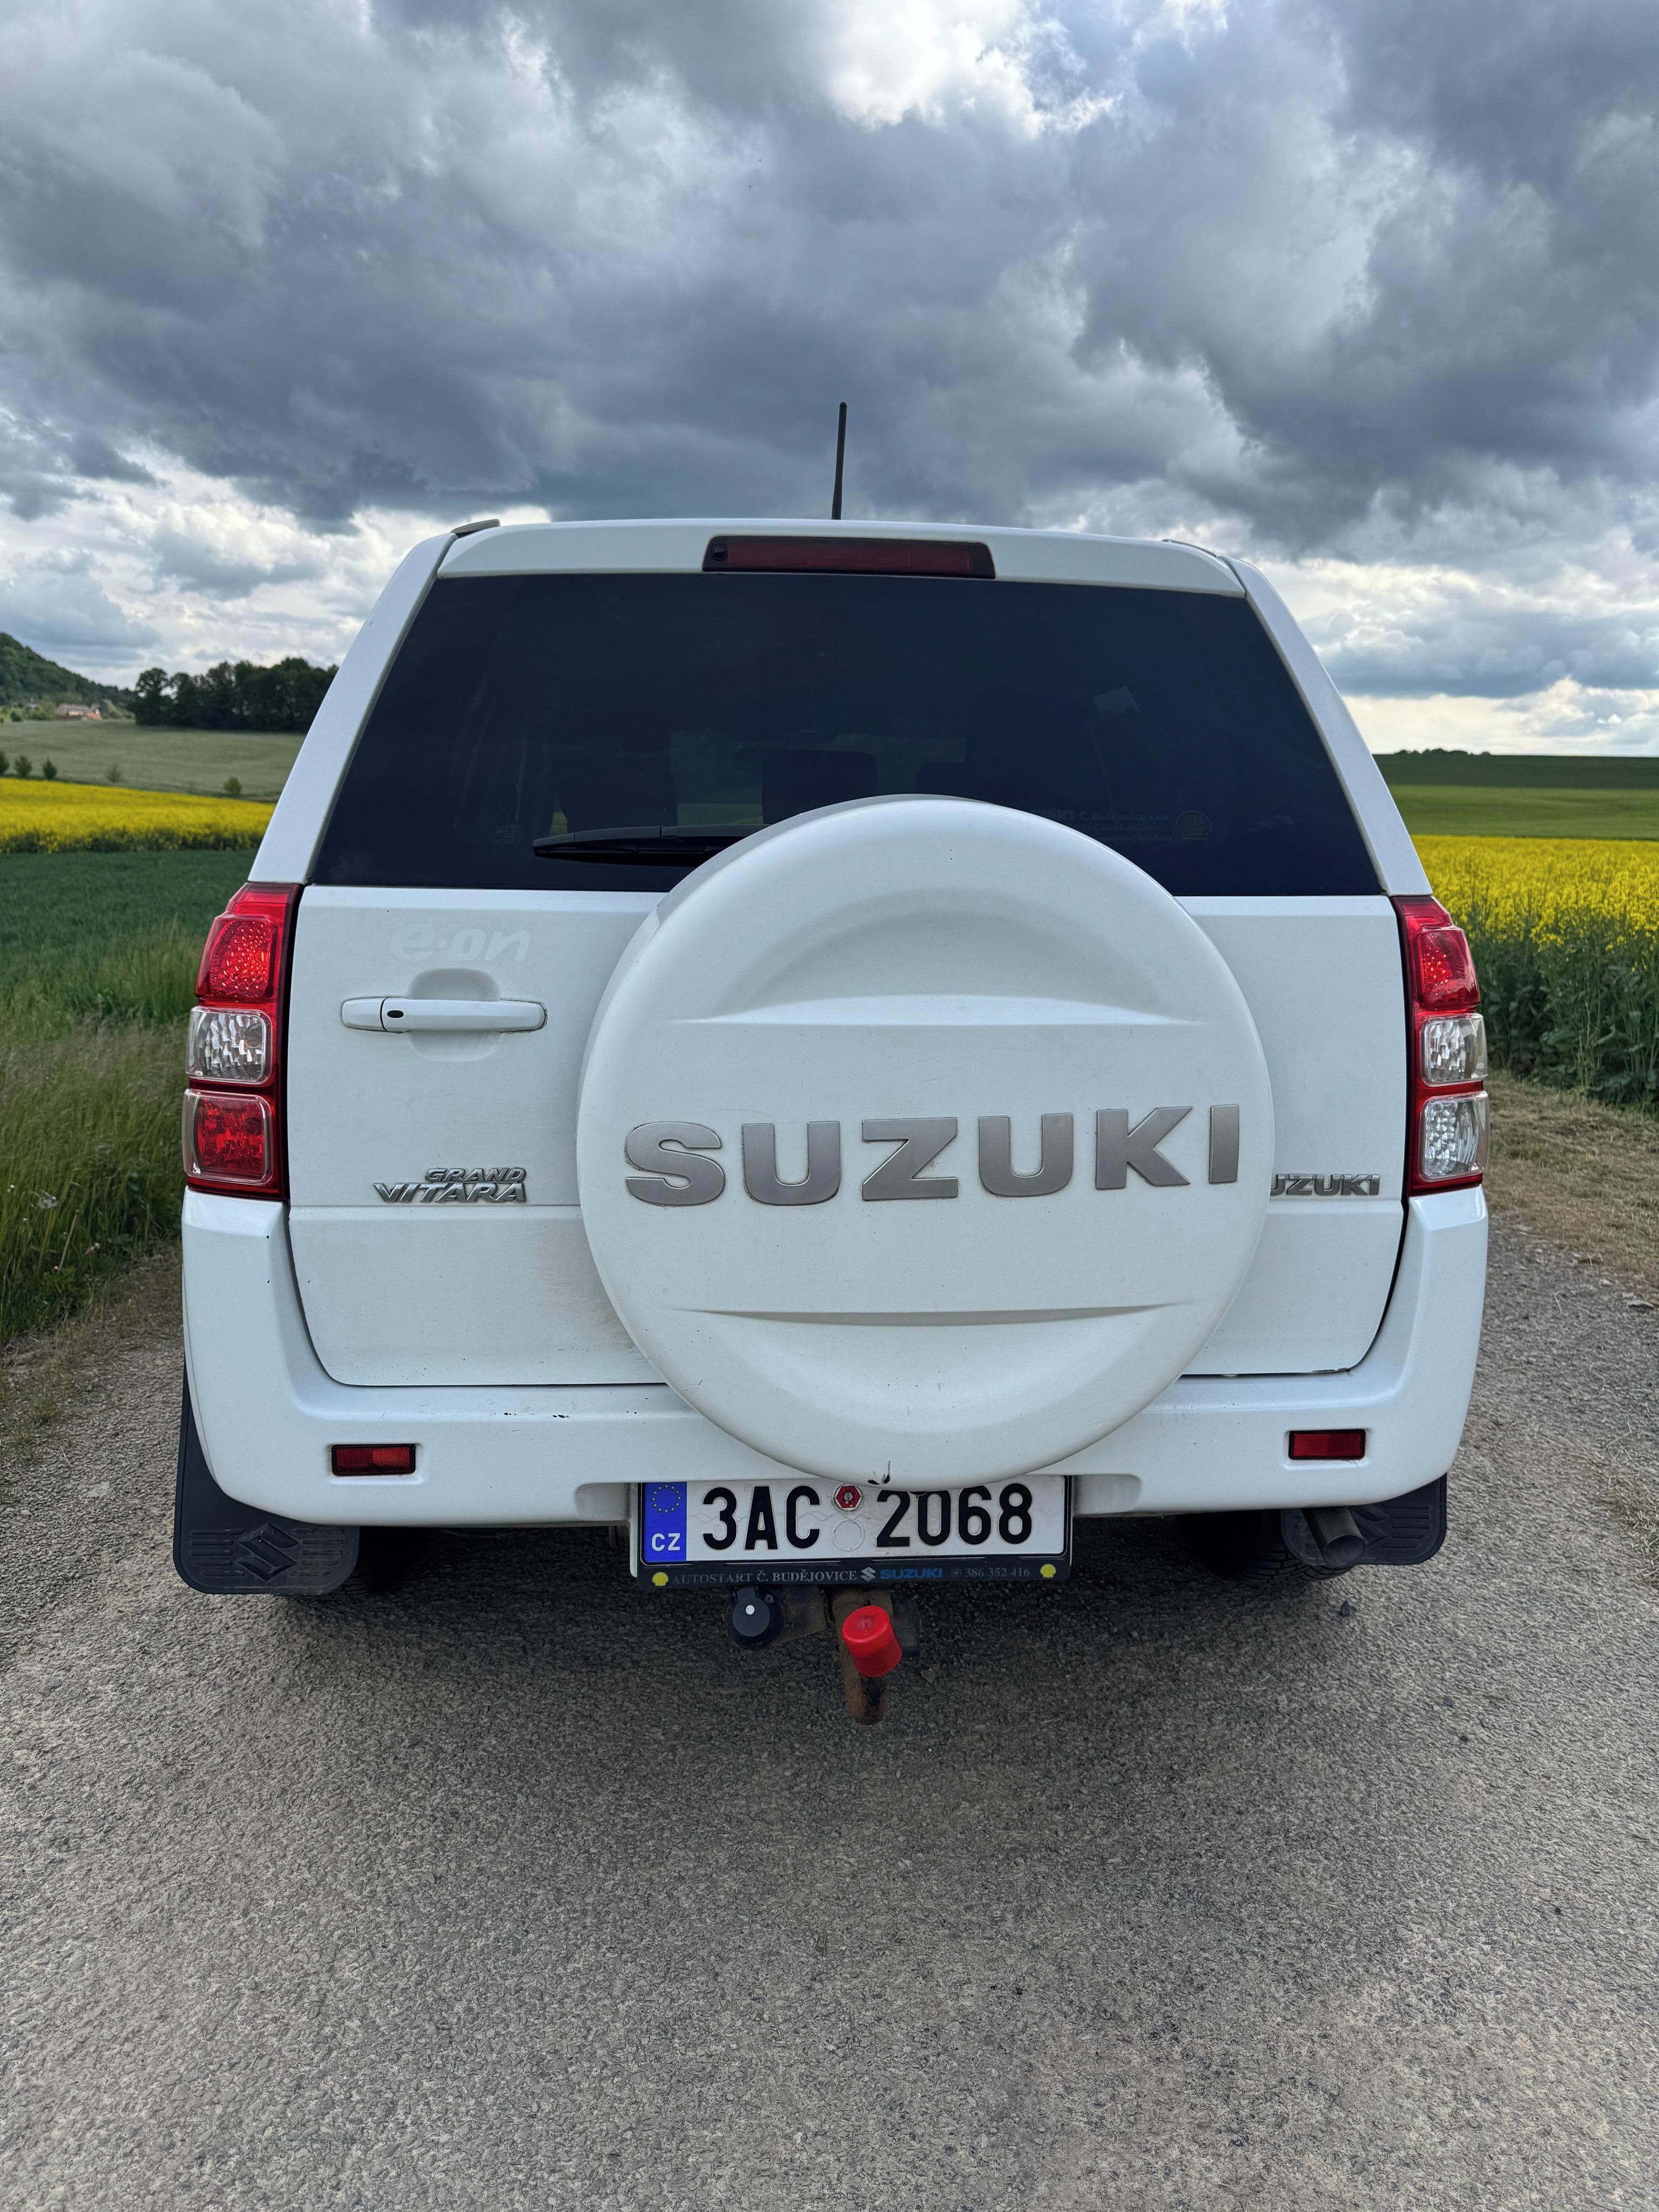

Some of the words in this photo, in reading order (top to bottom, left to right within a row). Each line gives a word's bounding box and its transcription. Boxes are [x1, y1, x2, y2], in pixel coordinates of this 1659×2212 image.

[625, 1104, 1239, 1206] SUZUKI
[424, 1167, 527, 1182] GRAND
[1269, 1173, 1380, 1197] UZUKI
[372, 1181, 527, 1203] VITARA
[703, 1485, 820, 1550] 3AC
[876, 1483, 1033, 1547] 2068
[651, 1533, 681, 1552] CZ
[672, 1572, 753, 1585] AUTOSTART
[757, 1569, 769, 1582] Č.
[772, 1569, 858, 1583] BUDĚJOVICE
[880, 1568, 943, 1580] SUZUKI
[965, 1568, 984, 1578] 386
[987, 1567, 1007, 1577] 352
[1010, 1567, 1030, 1577] 416
